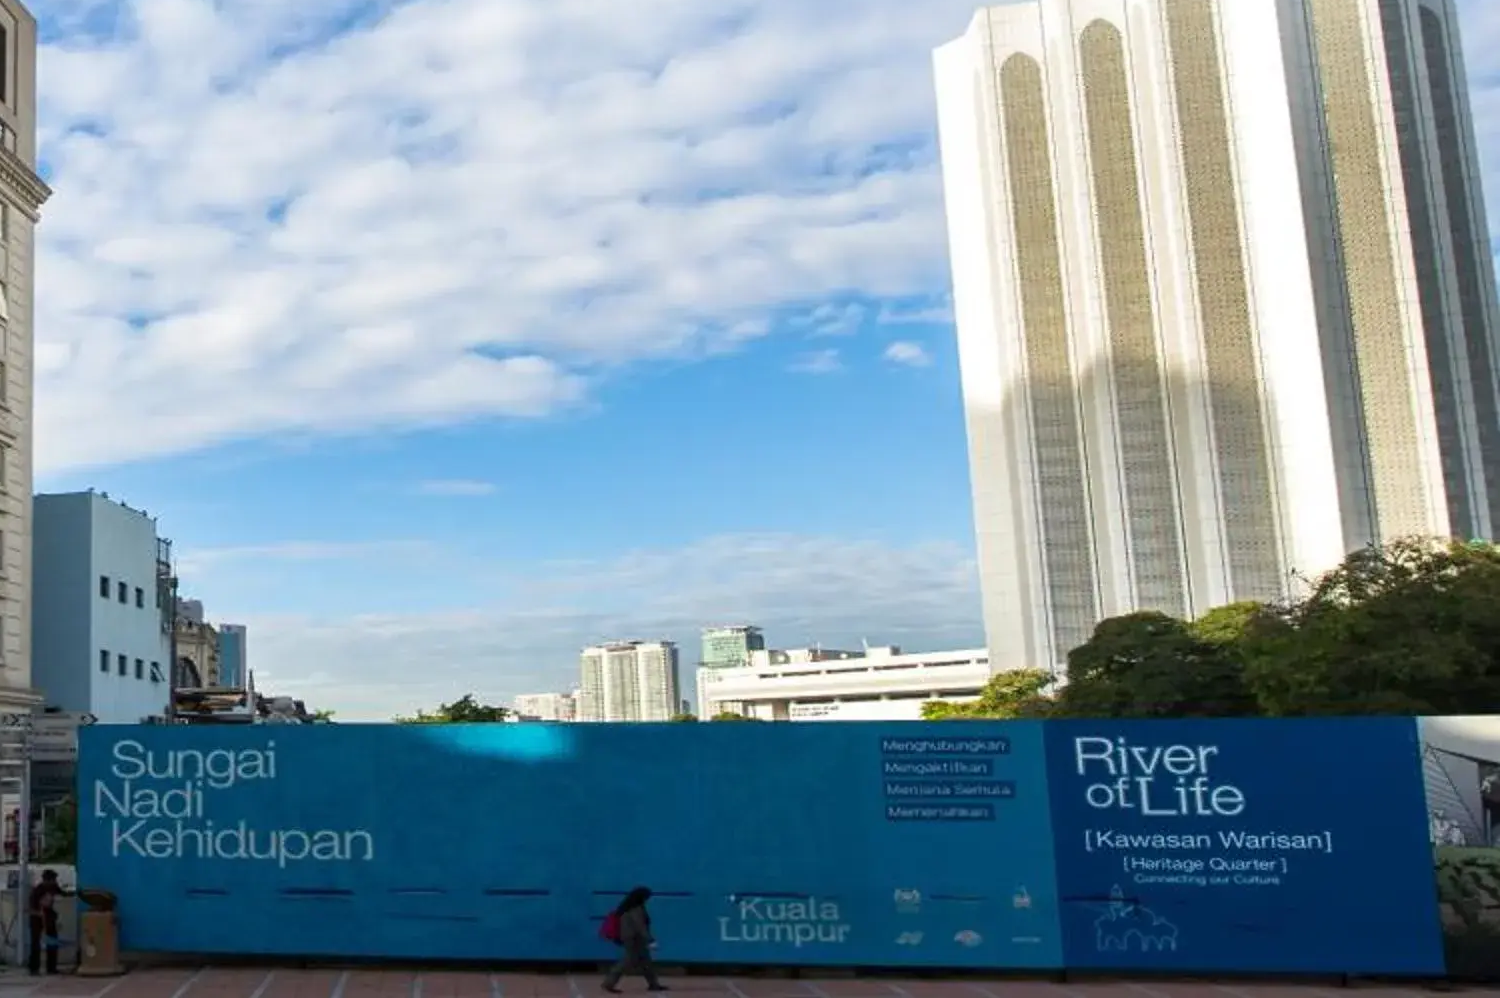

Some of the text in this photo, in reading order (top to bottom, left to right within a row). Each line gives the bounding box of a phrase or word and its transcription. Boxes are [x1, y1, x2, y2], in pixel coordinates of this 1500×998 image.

[111, 740, 276, 789] Sungai
[1075, 736, 1219, 776] River
[94, 779, 204, 819] Nadi
[1086, 775, 1246, 817] of Life
[111, 819, 374, 868] Kehidupan
[740, 896, 840, 921] Kuala
[717, 916, 851, 947] Lumpur
